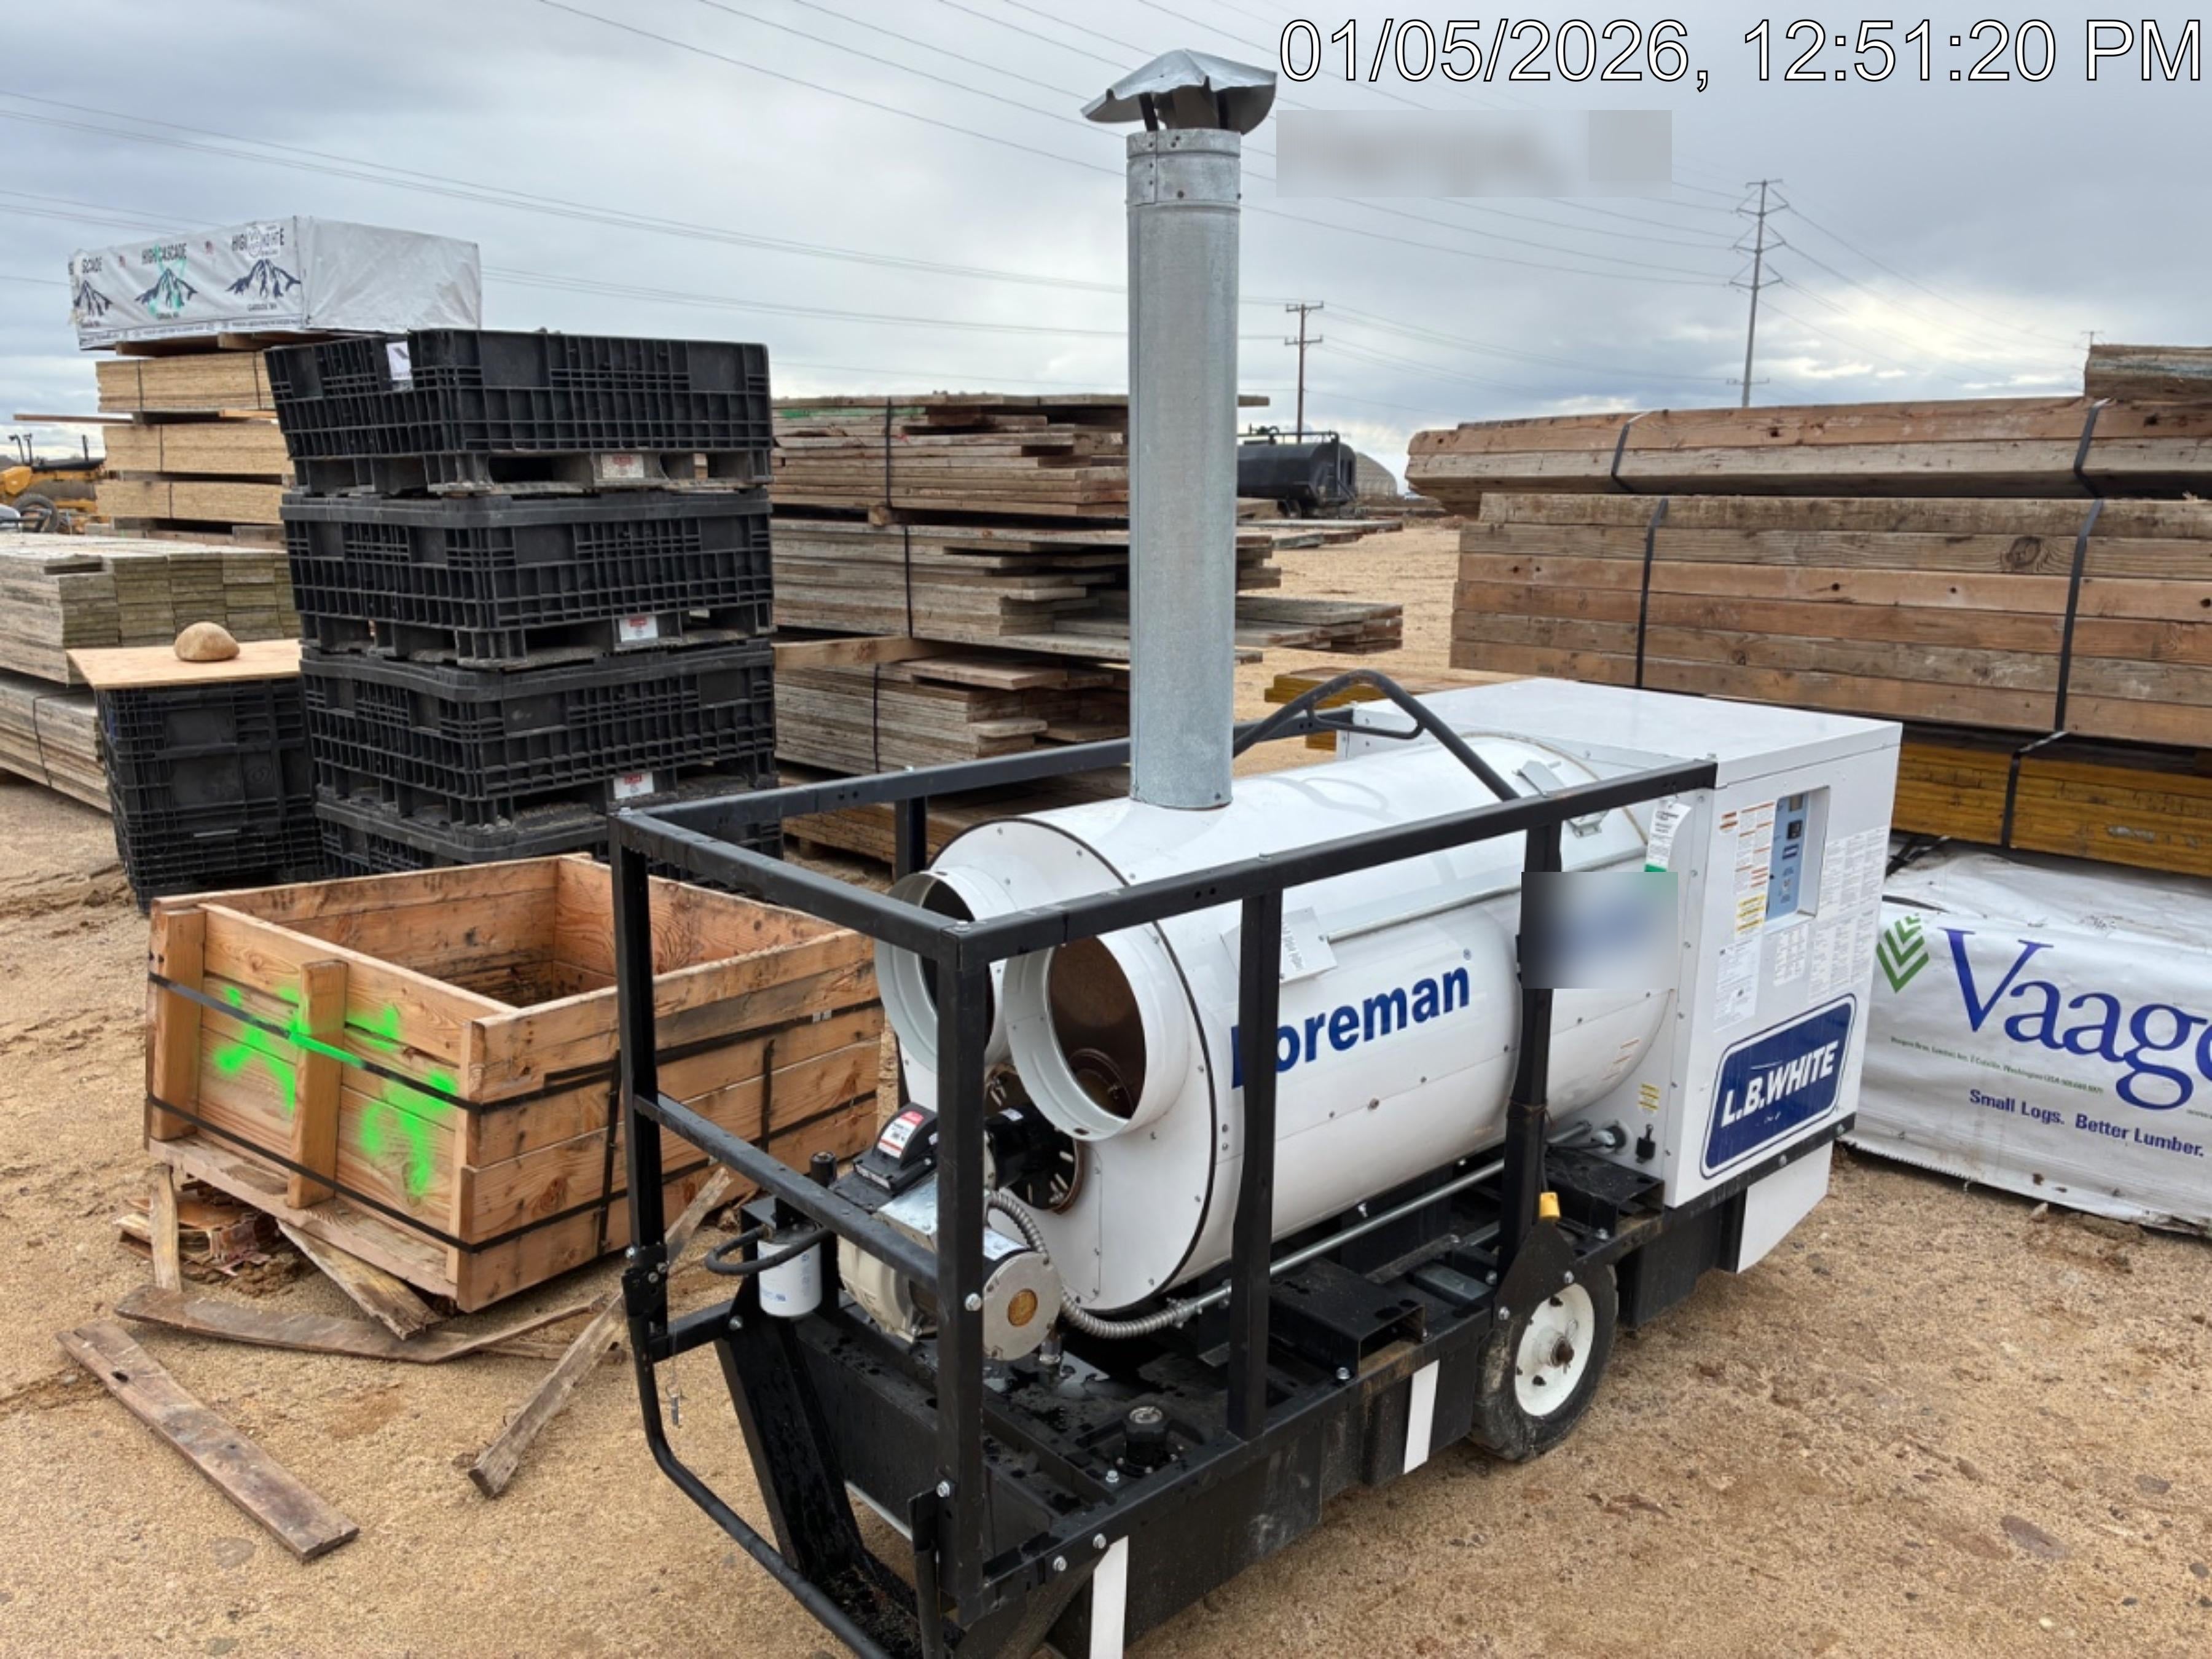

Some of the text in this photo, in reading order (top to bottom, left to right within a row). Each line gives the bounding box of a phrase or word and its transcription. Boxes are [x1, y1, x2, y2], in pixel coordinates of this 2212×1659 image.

[1231, 967, 1470, 1089] oreman
[1969, 1089, 2205, 1158] Small Logs. Better Lumber.
